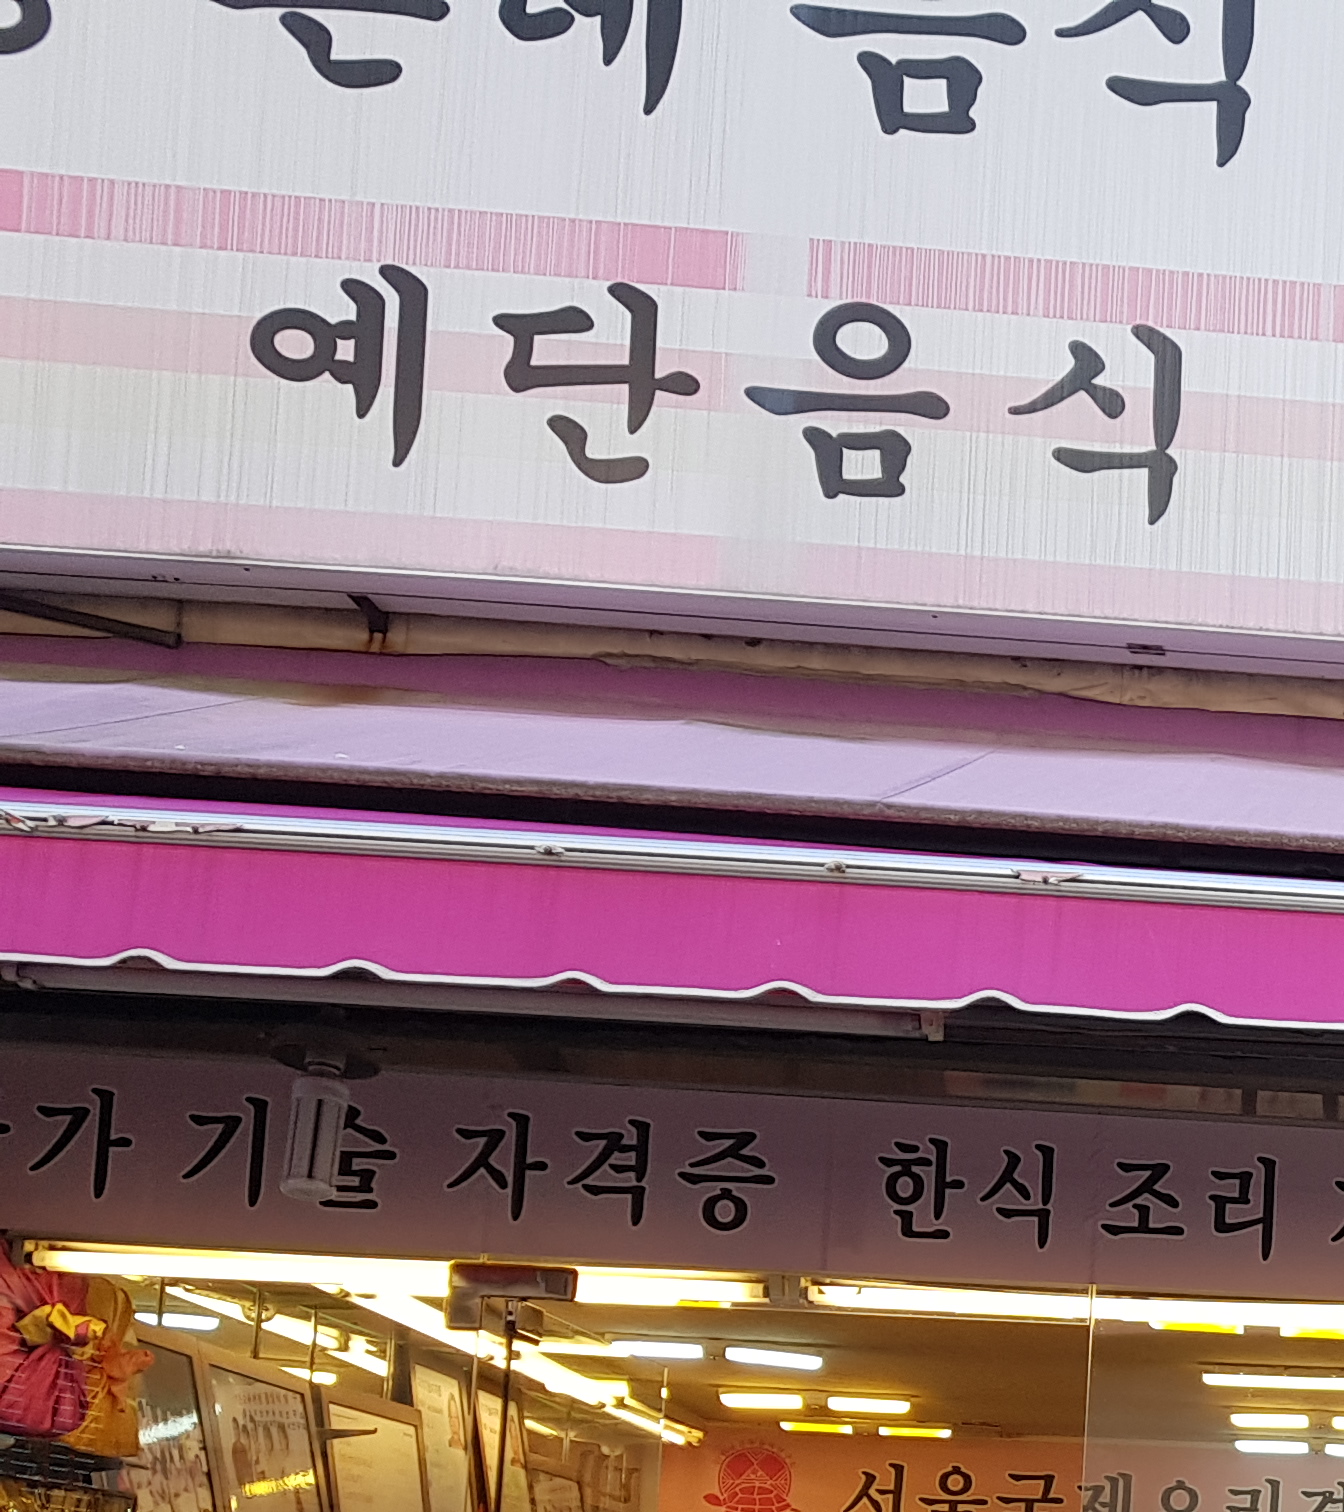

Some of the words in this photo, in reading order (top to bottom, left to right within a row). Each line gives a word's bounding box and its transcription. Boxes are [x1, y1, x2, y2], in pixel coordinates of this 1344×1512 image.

[0, 1087, 134, 1200] 가
[446, 1110, 777, 1232] 자격증
[877, 1136, 1056, 1250] 한식
[1101, 1155, 1280, 1262] 조리
